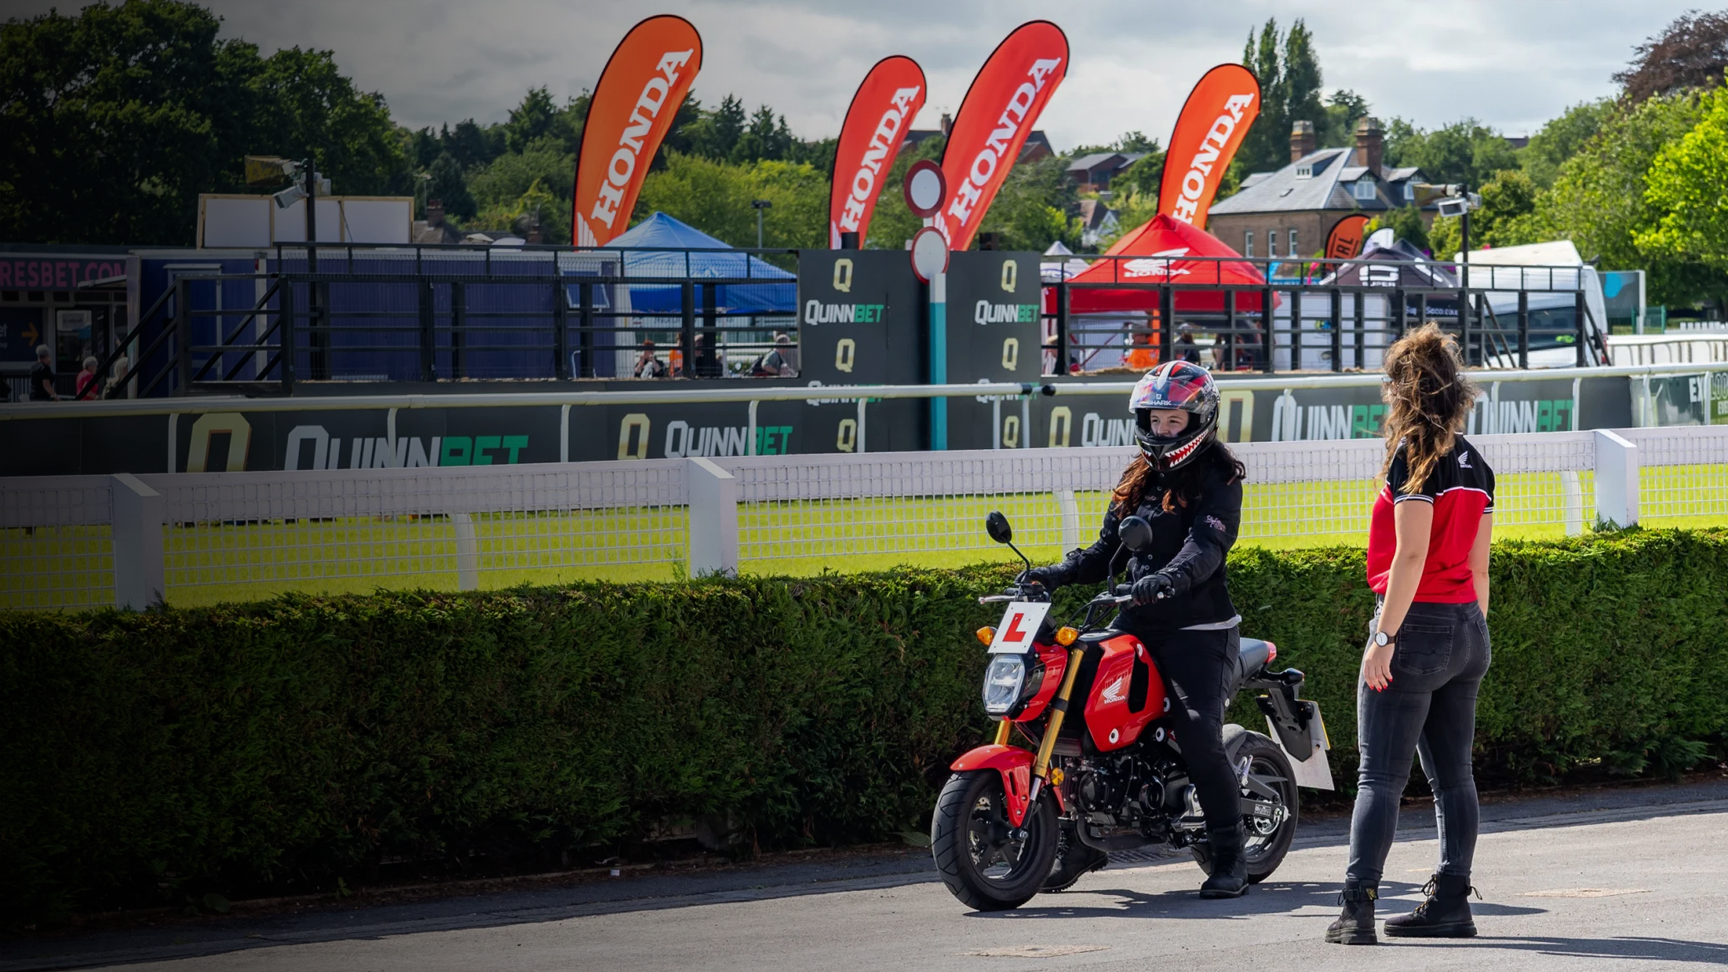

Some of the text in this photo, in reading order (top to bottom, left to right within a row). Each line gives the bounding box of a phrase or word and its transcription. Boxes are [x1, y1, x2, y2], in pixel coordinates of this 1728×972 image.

[591, 48, 694, 229] HONDA
[949, 57, 1062, 227] HONDA
[840, 85, 920, 233] HONDA
[1172, 92, 1255, 225] HONDA
[0, 261, 127, 287] RESBETCO
[833, 258, 853, 293] Q
[1001, 259, 1018, 293] Q
[804, 299, 885, 326] QUINNBET
[974, 300, 1040, 326] QUINNBET
[835, 338, 856, 373] Q
[1002, 338, 1019, 372] Q
[285, 425, 529, 470] QUINNBET
[664, 420, 793, 458] QUINNBET
[837, 418, 857, 452] Q
[1002, 415, 1020, 448] Q
[1002, 612, 1027, 643] L
[1104, 695, 1126, 704] HONDA
